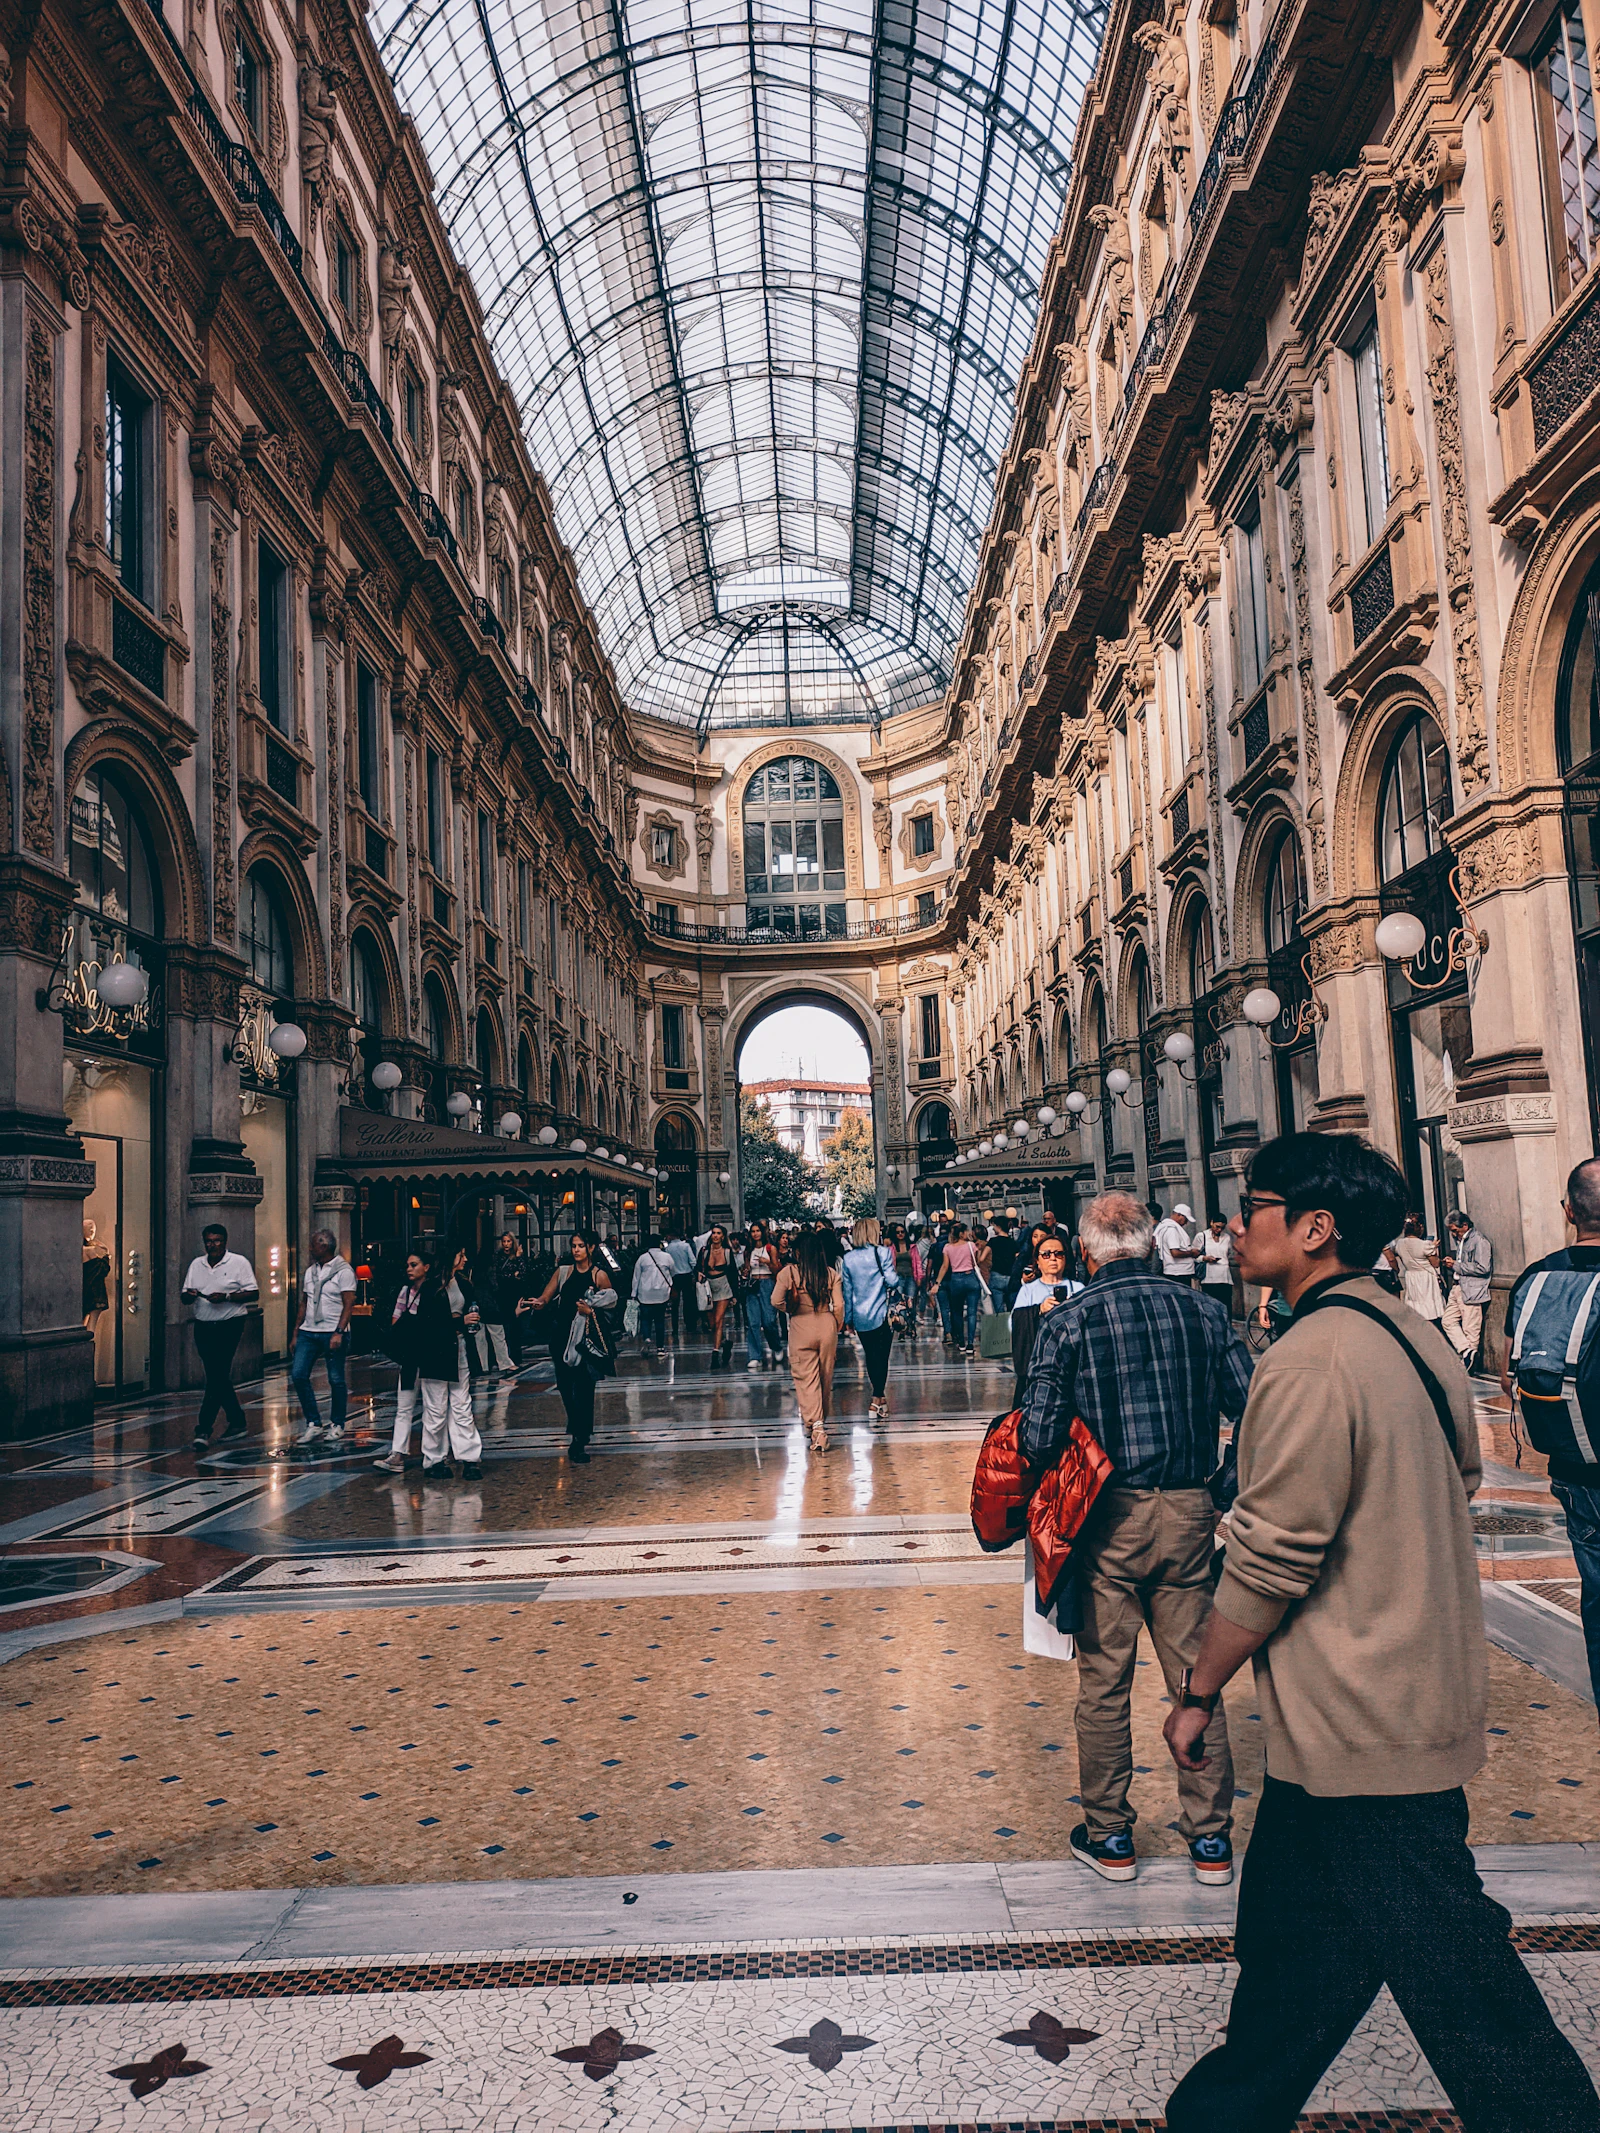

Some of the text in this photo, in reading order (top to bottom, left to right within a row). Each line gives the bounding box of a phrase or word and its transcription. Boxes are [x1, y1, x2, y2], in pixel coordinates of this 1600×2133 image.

[355, 1123, 434, 1146] Galleria
[356, 1149, 416, 1158] RESTAURANT
[423, 1147, 451, 1156] WOOD
[1017, 1145, 1072, 1160] il Salotto
[658, 1164, 690, 1172] MONCLER
